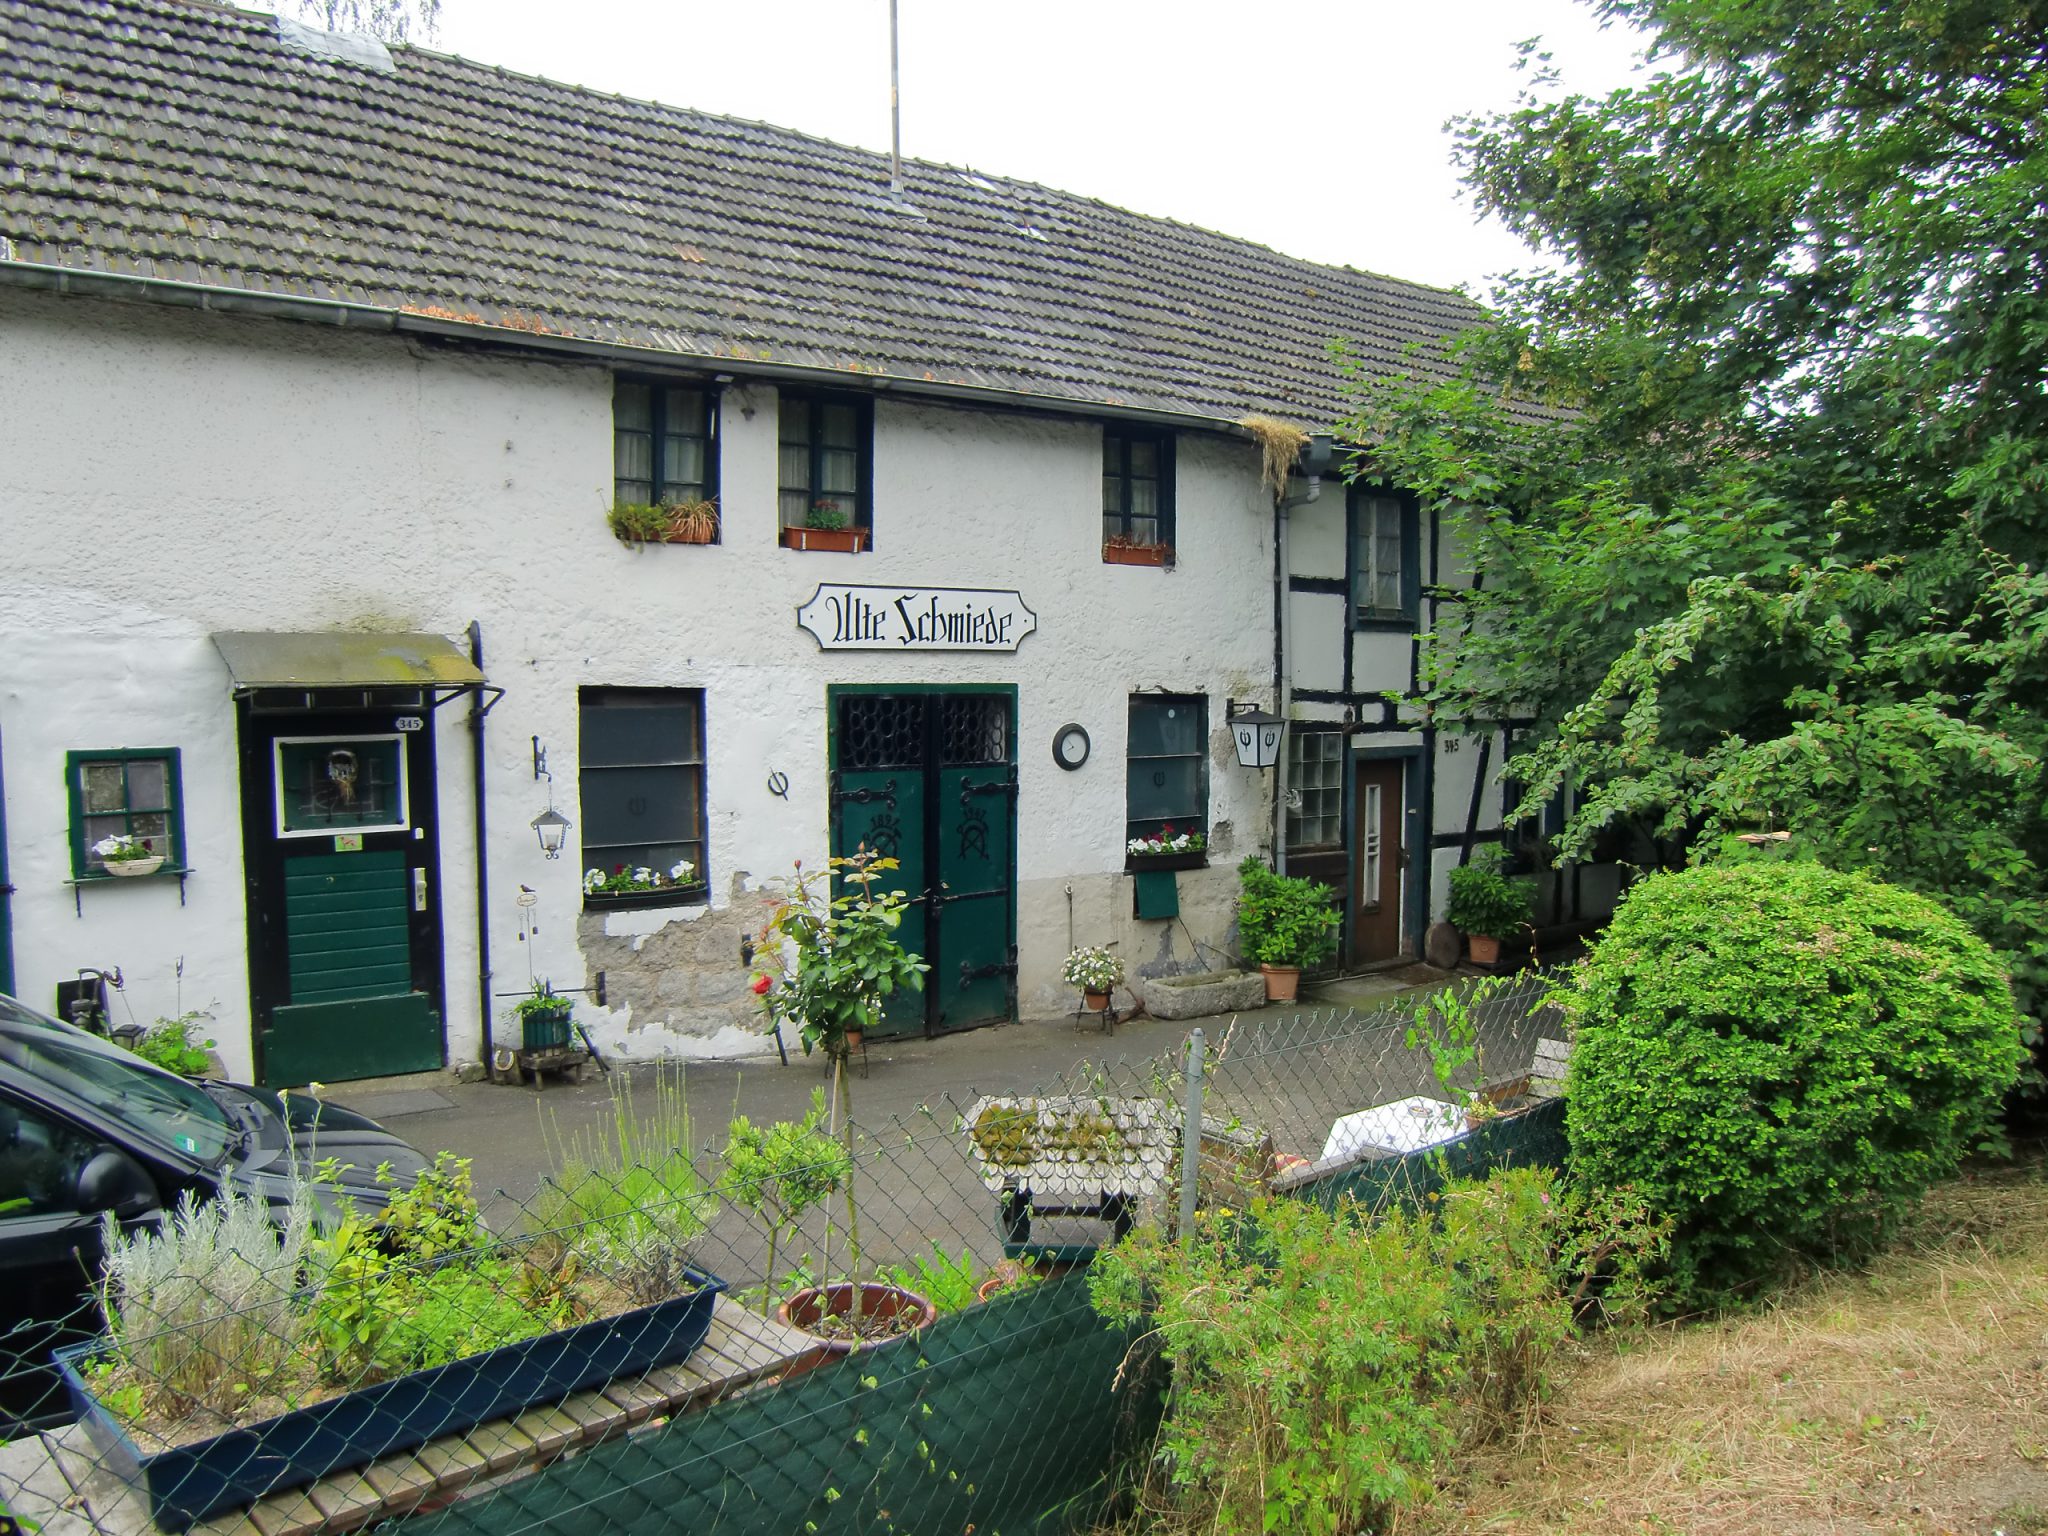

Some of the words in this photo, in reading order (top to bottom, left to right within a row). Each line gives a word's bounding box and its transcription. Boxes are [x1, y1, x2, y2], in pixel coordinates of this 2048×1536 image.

[825, 591, 886, 642] Alte
[893, 592, 1012, 646] Schmiede
[399, 719, 420, 729] 345
